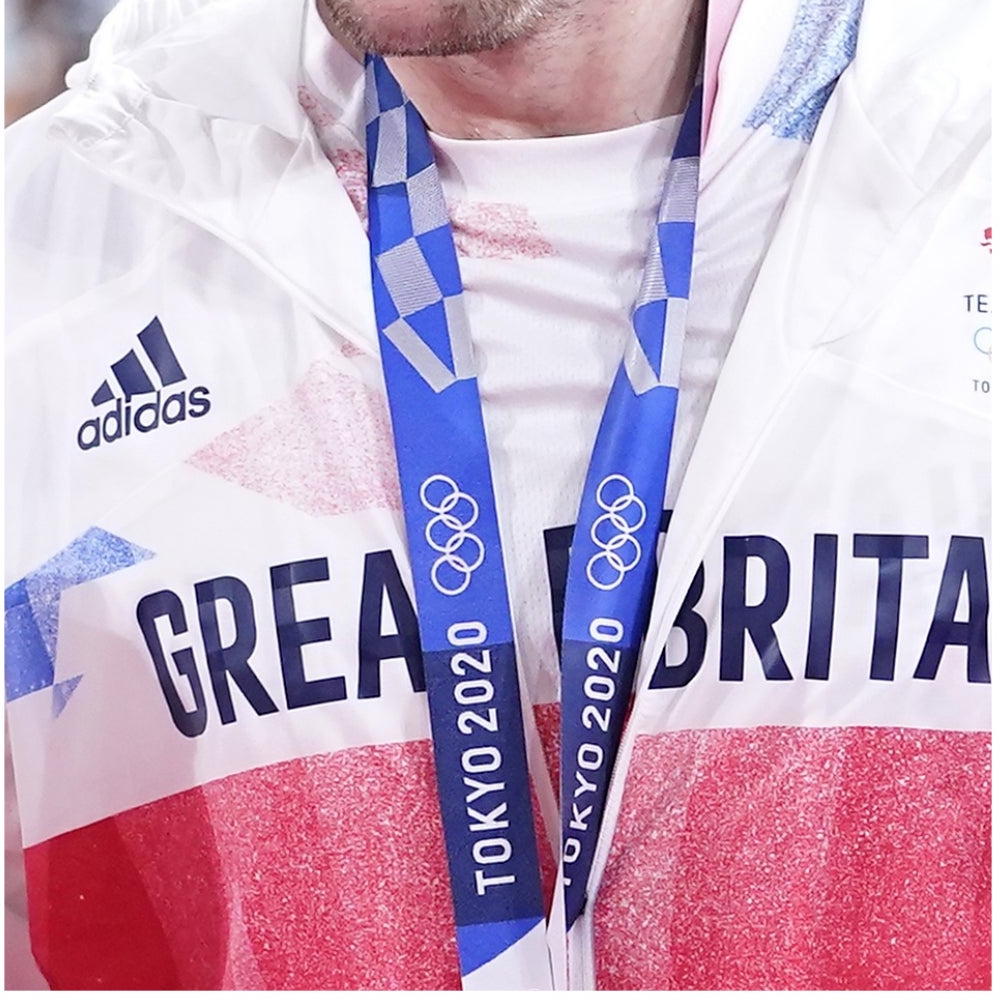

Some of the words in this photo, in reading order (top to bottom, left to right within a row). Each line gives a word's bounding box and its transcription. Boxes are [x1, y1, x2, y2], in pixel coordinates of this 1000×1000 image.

[963, 294, 992, 314] TE
[77, 385, 211, 451] adidas
[136, 549, 426, 738] GREA
[447, 620, 499, 735] 2020
[582, 617, 624, 732] 2020
[461, 746, 515, 895] TOKYO
[563, 743, 604, 886] OKYO
